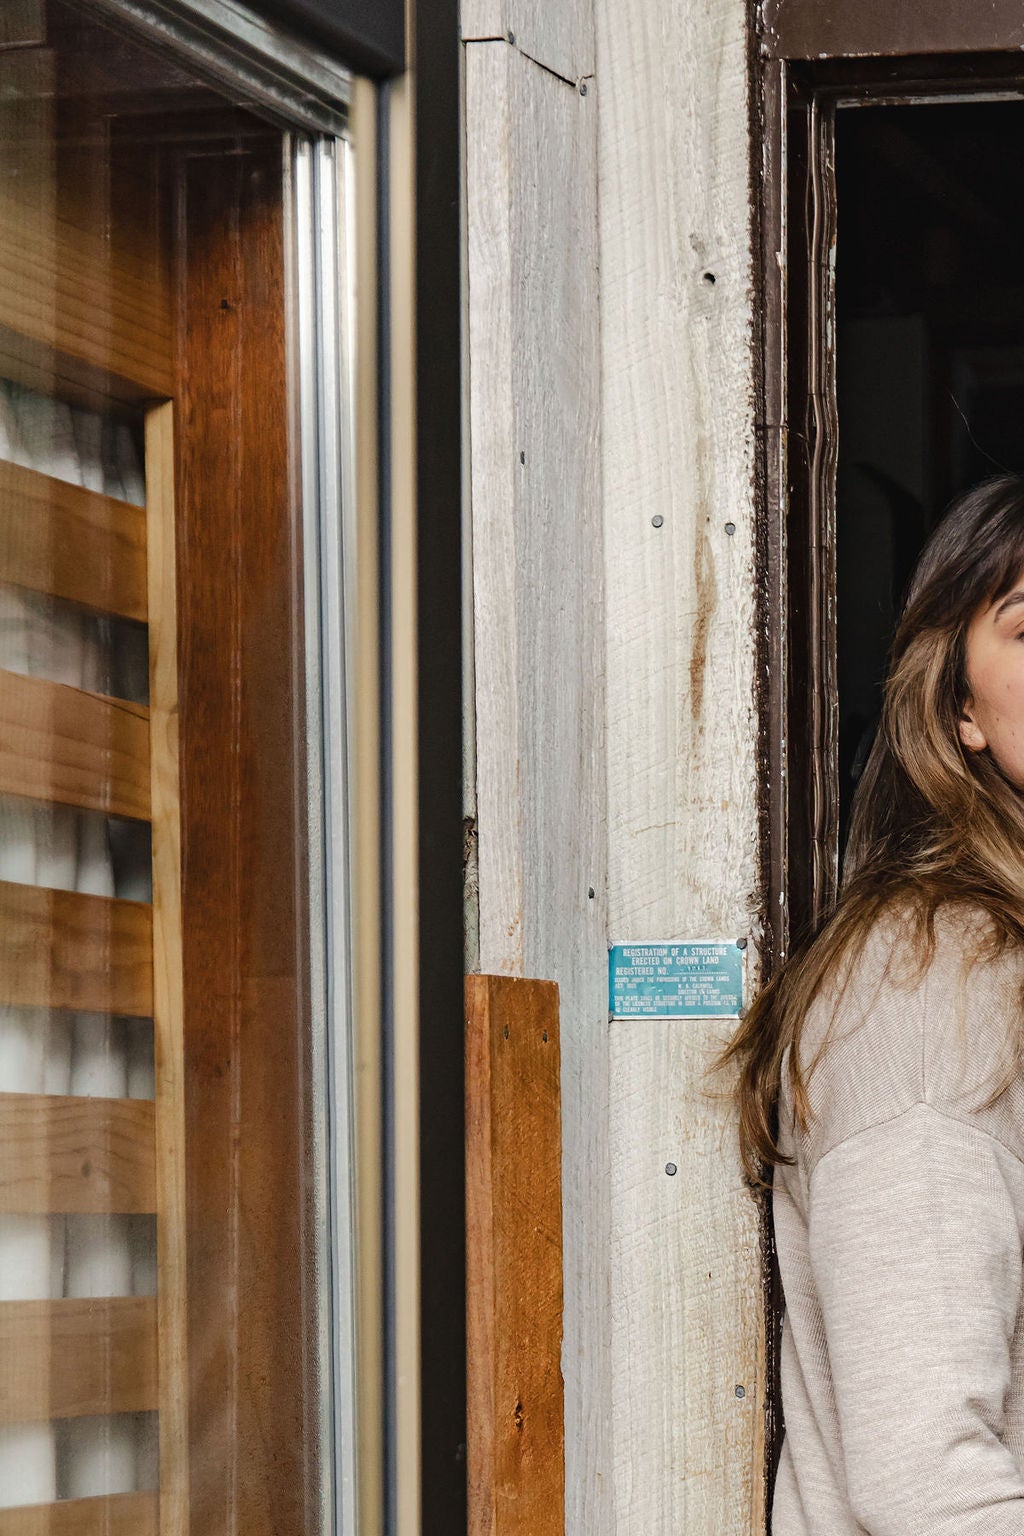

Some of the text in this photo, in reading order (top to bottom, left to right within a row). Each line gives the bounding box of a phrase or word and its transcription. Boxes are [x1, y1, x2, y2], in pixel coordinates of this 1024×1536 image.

[623, 947, 727, 956] REGISTRATION OF A STRUCTURE
[632, 956, 719, 965] ERECTED ON CROWN LAND
[615, 967, 654, 976] REGISTERED
